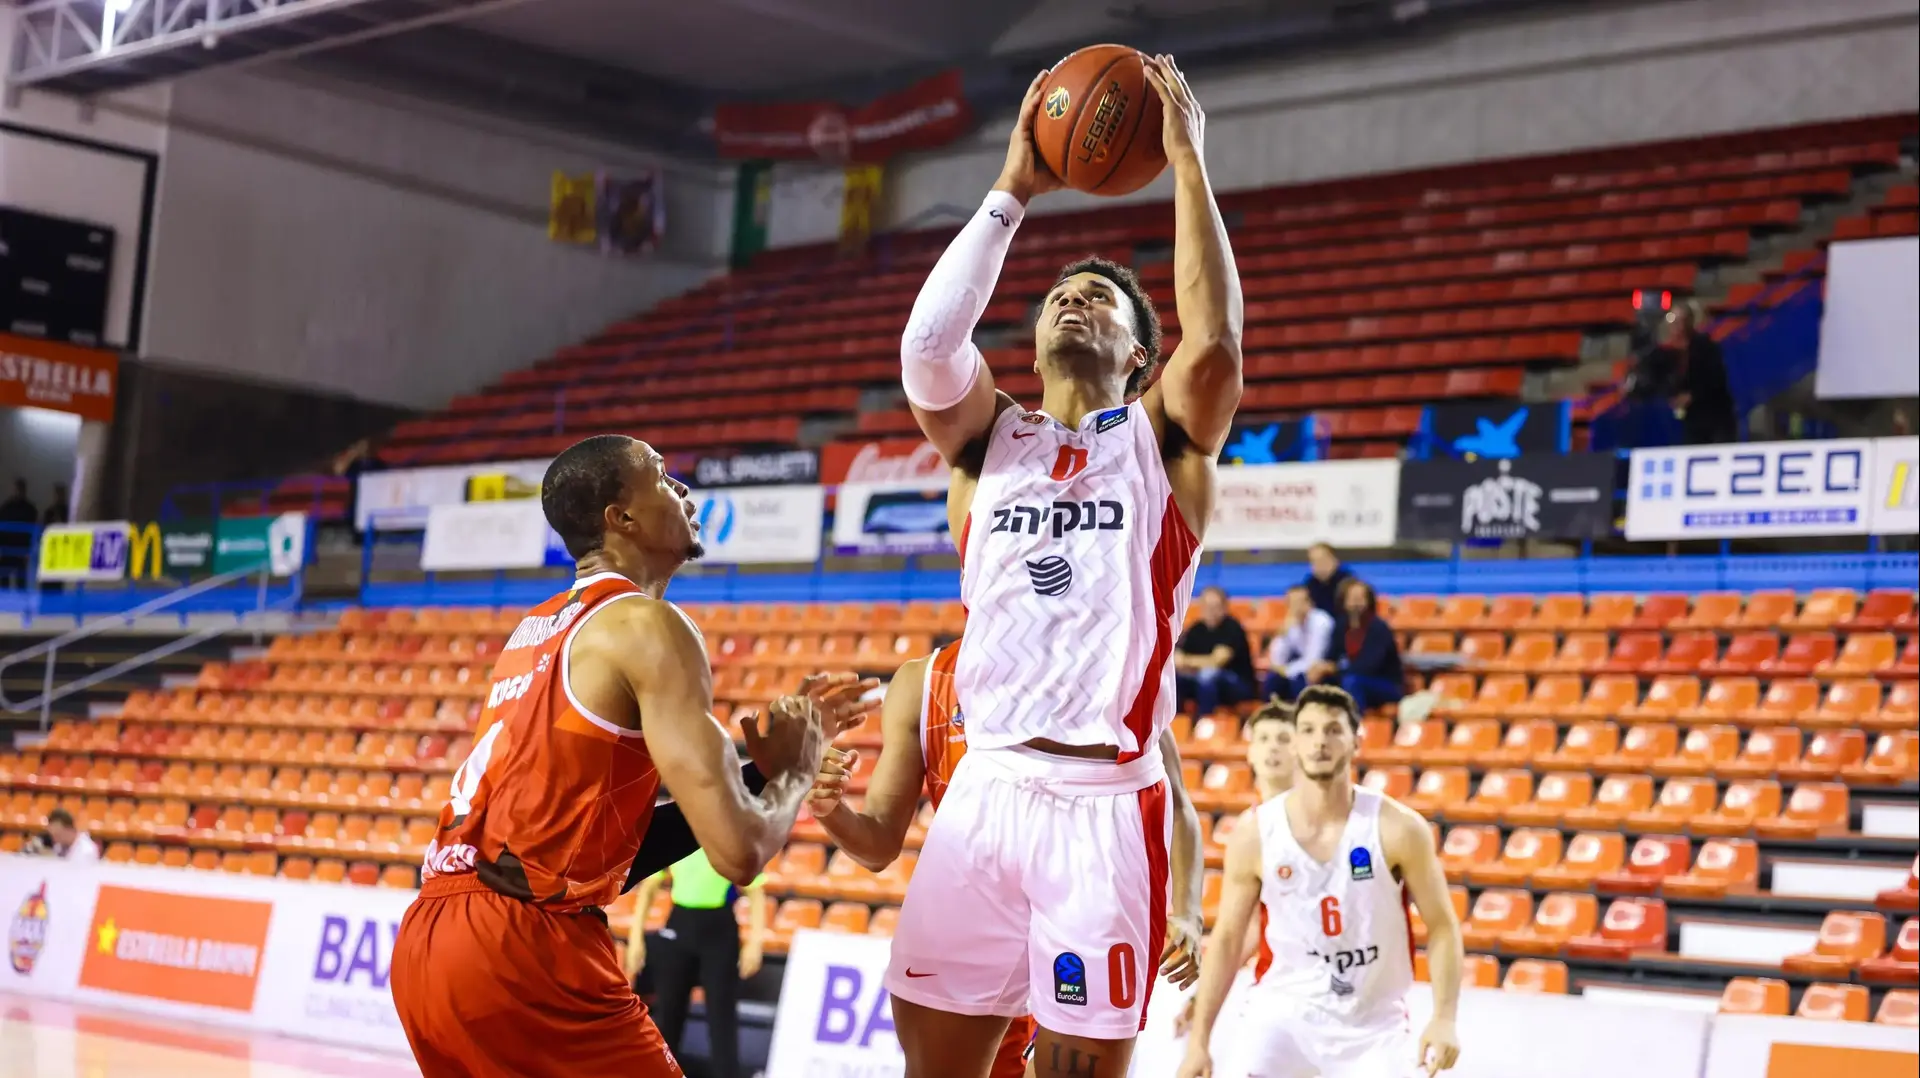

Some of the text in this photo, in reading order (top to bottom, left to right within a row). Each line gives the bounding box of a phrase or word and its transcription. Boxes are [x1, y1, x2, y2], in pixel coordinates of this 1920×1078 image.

[0, 353, 112, 397] STRELLA
[1050, 444, 1089, 482] 0
[1320, 896, 1342, 936] 6
[1108, 942, 1136, 1009] 0
[1057, 992, 1085, 1003] EuroCup
